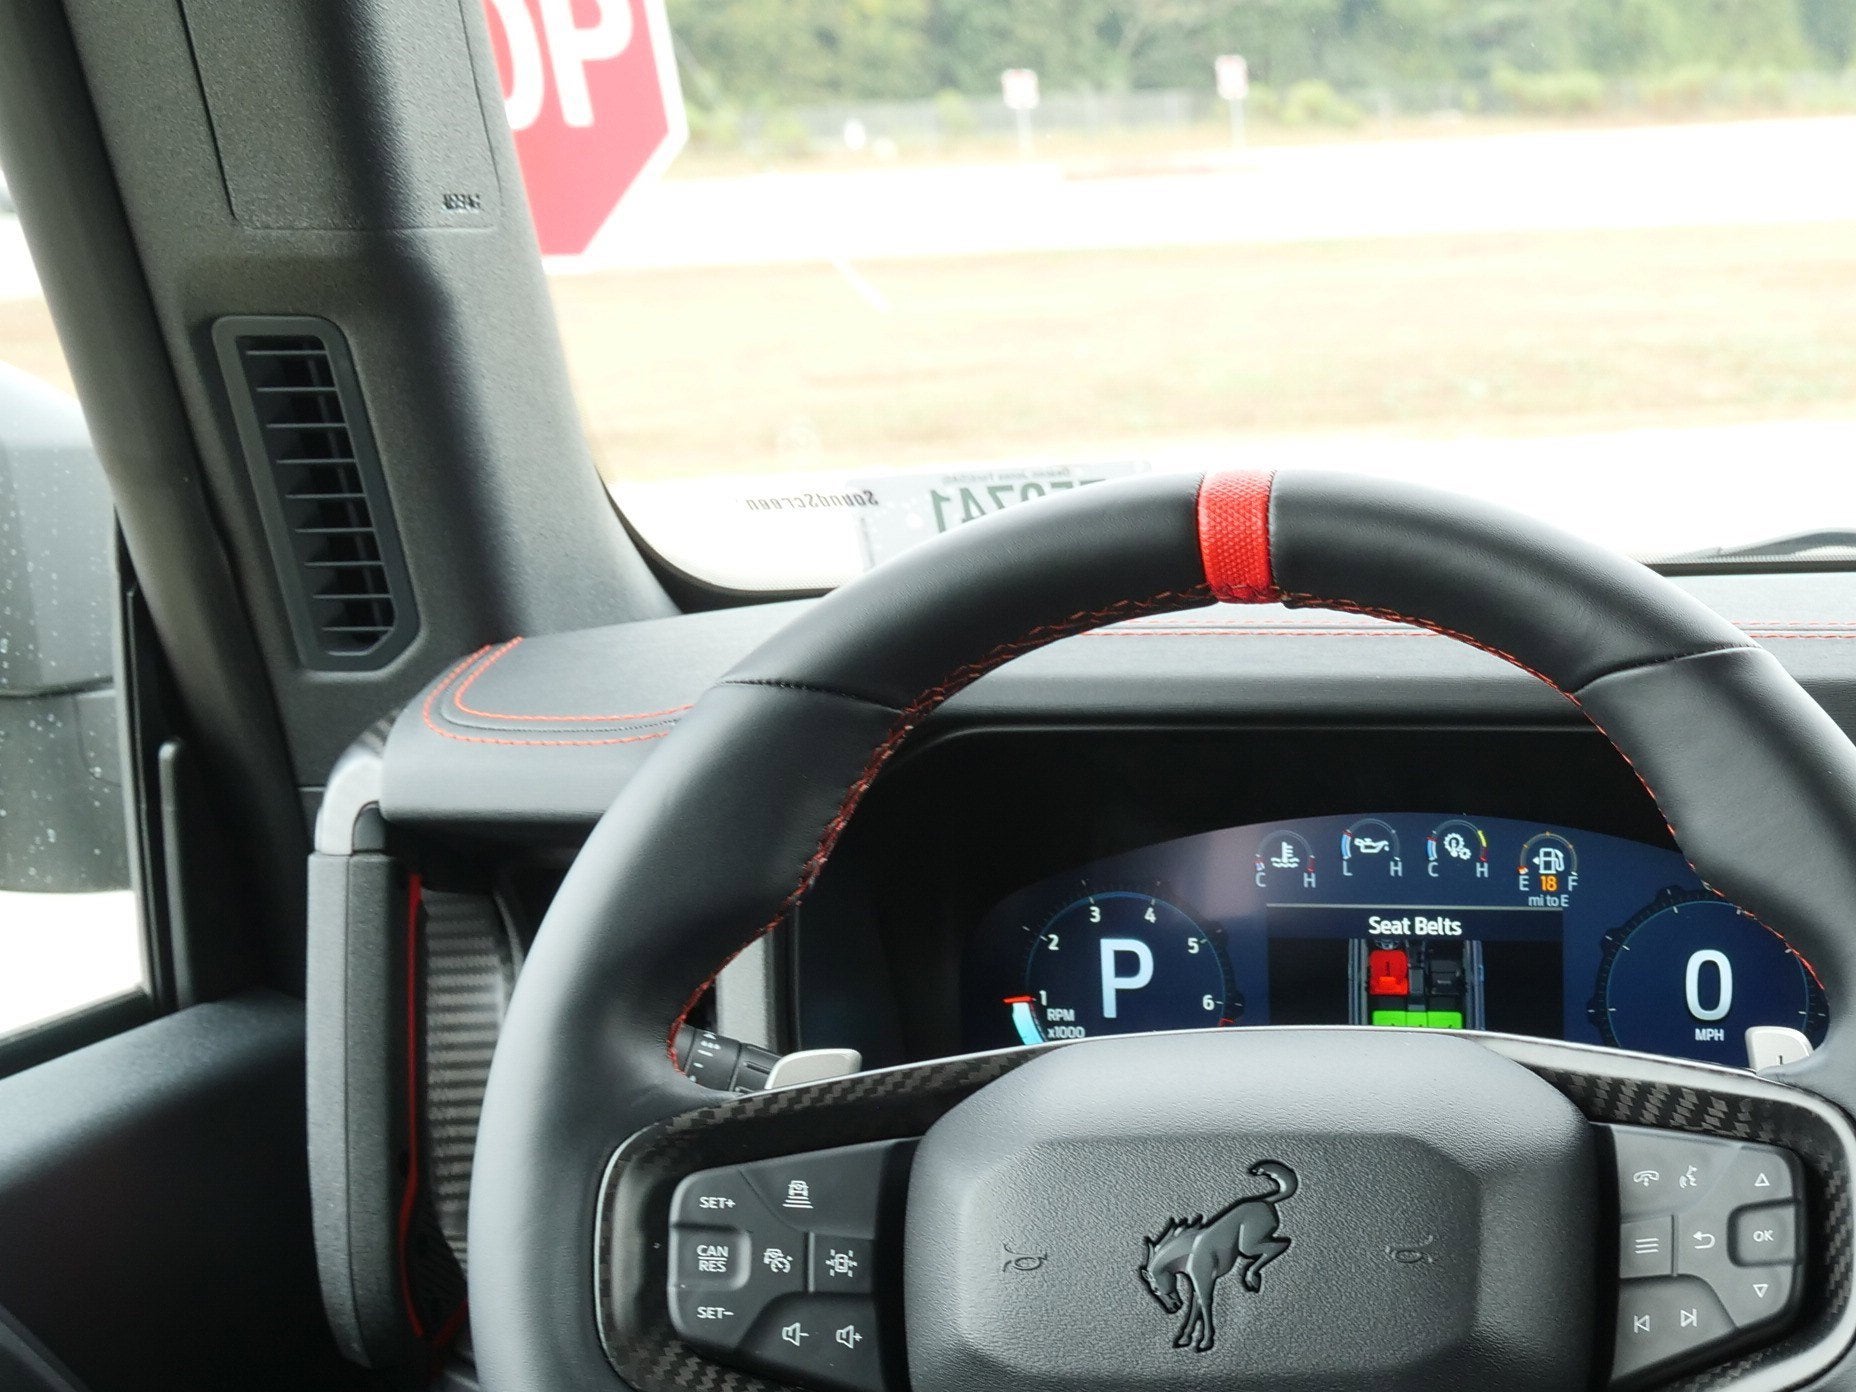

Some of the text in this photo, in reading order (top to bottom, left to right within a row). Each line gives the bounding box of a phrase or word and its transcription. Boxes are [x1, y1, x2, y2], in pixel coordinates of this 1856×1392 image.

[1342, 861, 1352, 876] L
[1390, 861, 1403, 877] H
[1428, 862, 1439, 877] C
[1476, 862, 1489, 878] H
[1255, 872, 1266, 888] C
[1303, 873, 1316, 888] H
[1519, 875, 1529, 891] E
[1540, 875, 1557, 891] 18
[1568, 876, 1578, 891] F
[1528, 894, 1569, 907] mi to E
[1089, 906, 1101, 923] 3
[1144, 907, 1157, 923] 4
[1368, 916, 1463, 936] Seat Belts
[1048, 934, 1059, 950] 2
[1187, 938, 1199, 954] 5
[1100, 938, 1154, 1018] P
[1686, 948, 1732, 1021] 0
[1039, 990, 1047, 1006] 1
[1202, 995, 1214, 1010] 6
[1046, 1009, 1075, 1022] RPM
[1047, 1026, 1086, 1038] x1000
[1695, 1028, 1725, 1041] MPH
[1753, 1229, 1774, 1242] OK
[696, 1244, 729, 1258] CAN
[698, 1259, 727, 1273] RES
